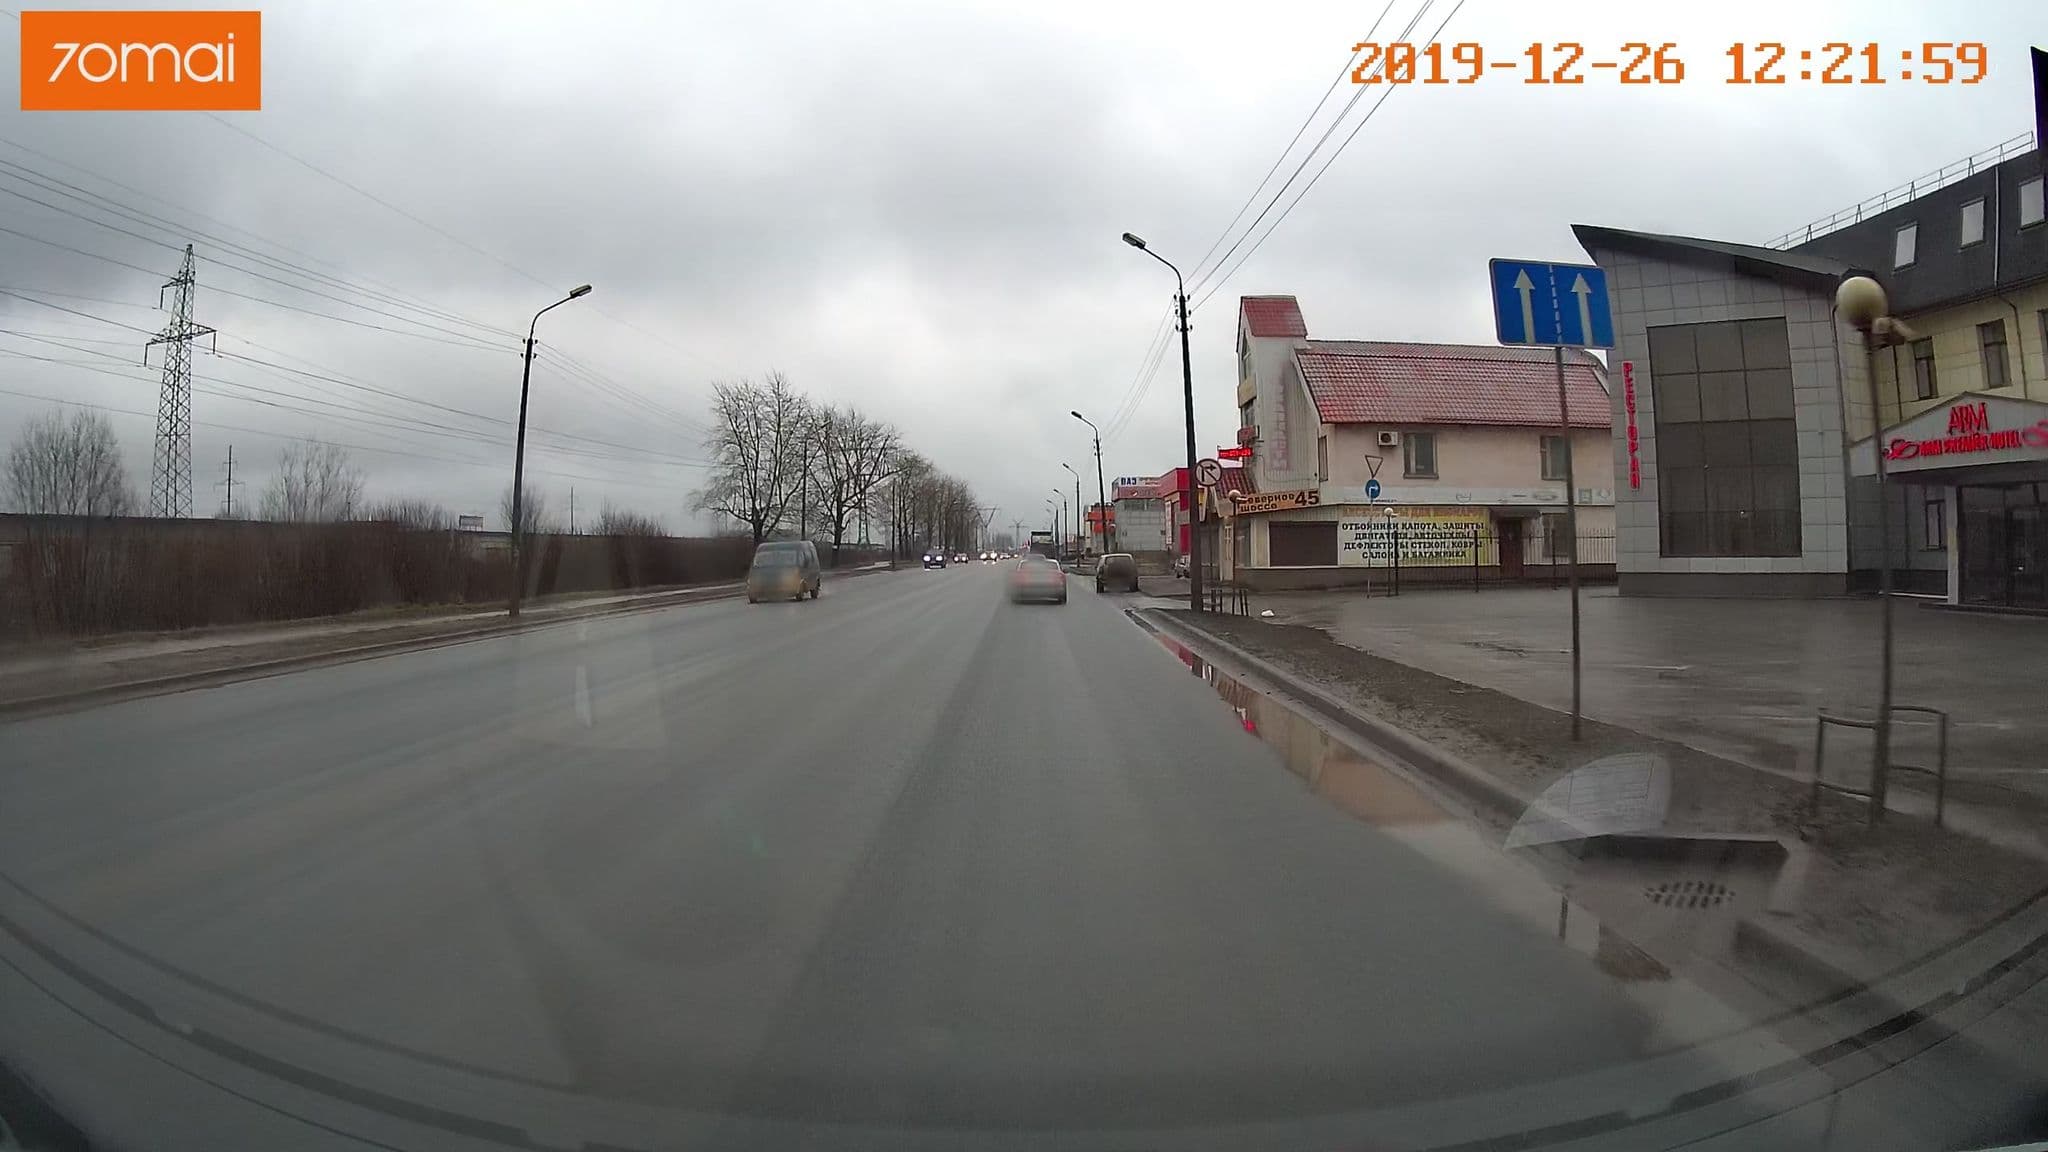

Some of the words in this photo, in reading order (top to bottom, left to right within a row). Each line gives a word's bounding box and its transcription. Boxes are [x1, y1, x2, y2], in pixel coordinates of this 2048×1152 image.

[1622, 362, 1640, 490] РЕСТОРАН
[1295, 490, 1320, 506] 45
[1442, 522, 1484, 530] ЗАЩИТЫ
[1343, 542, 1408, 550] ДЕФЛЕКТОЫ
